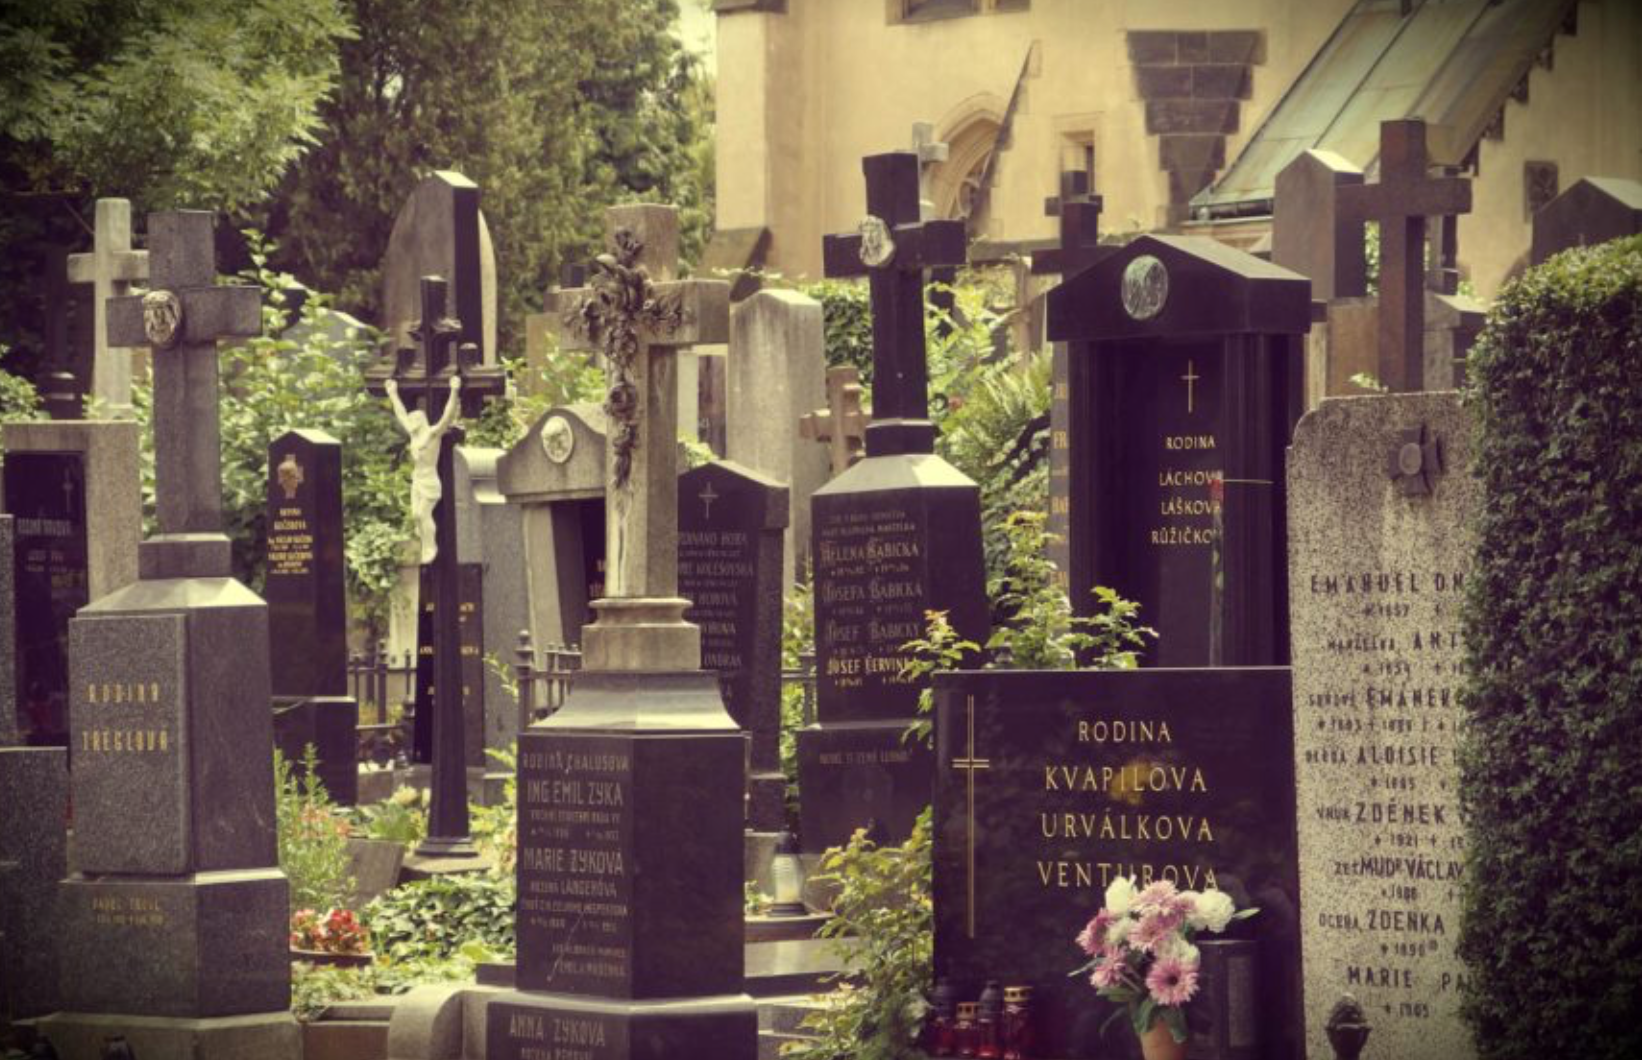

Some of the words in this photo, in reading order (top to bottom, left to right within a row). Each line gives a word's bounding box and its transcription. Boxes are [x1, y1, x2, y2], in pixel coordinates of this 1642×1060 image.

[1166, 435, 1216, 450] RODINA
[1310, 573, 1420, 594] EMANUEL
[827, 657, 861, 675] JOSEF
[1078, 720, 1172, 743] RODINA
[1357, 746, 1439, 767] ALOISIE
[1045, 765, 1208, 793] KVAPILOVA
[553, 780, 585, 805] EMIL
[1041, 807, 1214, 842] URVÁLKOVA
[523, 847, 564, 872] MARIE
[1037, 860, 1220, 891] VENTUROVA
[1367, 909, 1446, 934] ZDENKA
[1347, 966, 1413, 989] MARIE
[510, 1014, 544, 1040] ANNA
